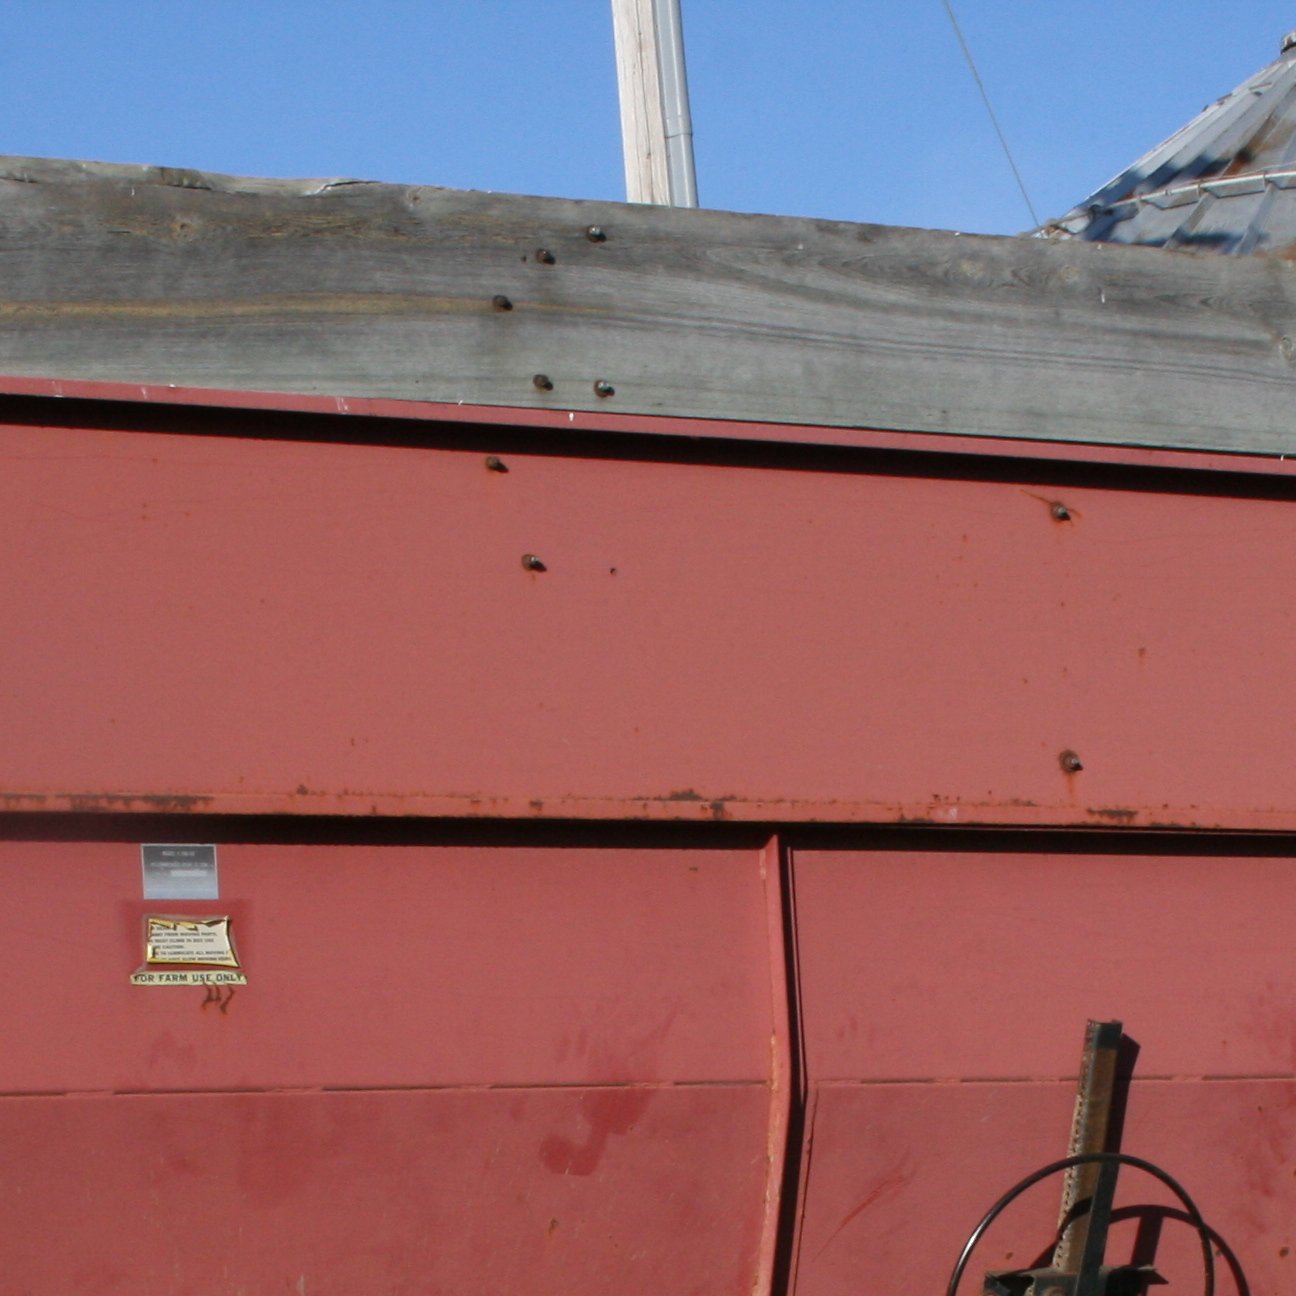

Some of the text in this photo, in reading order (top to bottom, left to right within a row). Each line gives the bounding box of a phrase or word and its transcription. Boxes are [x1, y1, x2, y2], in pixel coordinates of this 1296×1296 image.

[133, 973, 242, 982] FOR FARM USE ONLY
